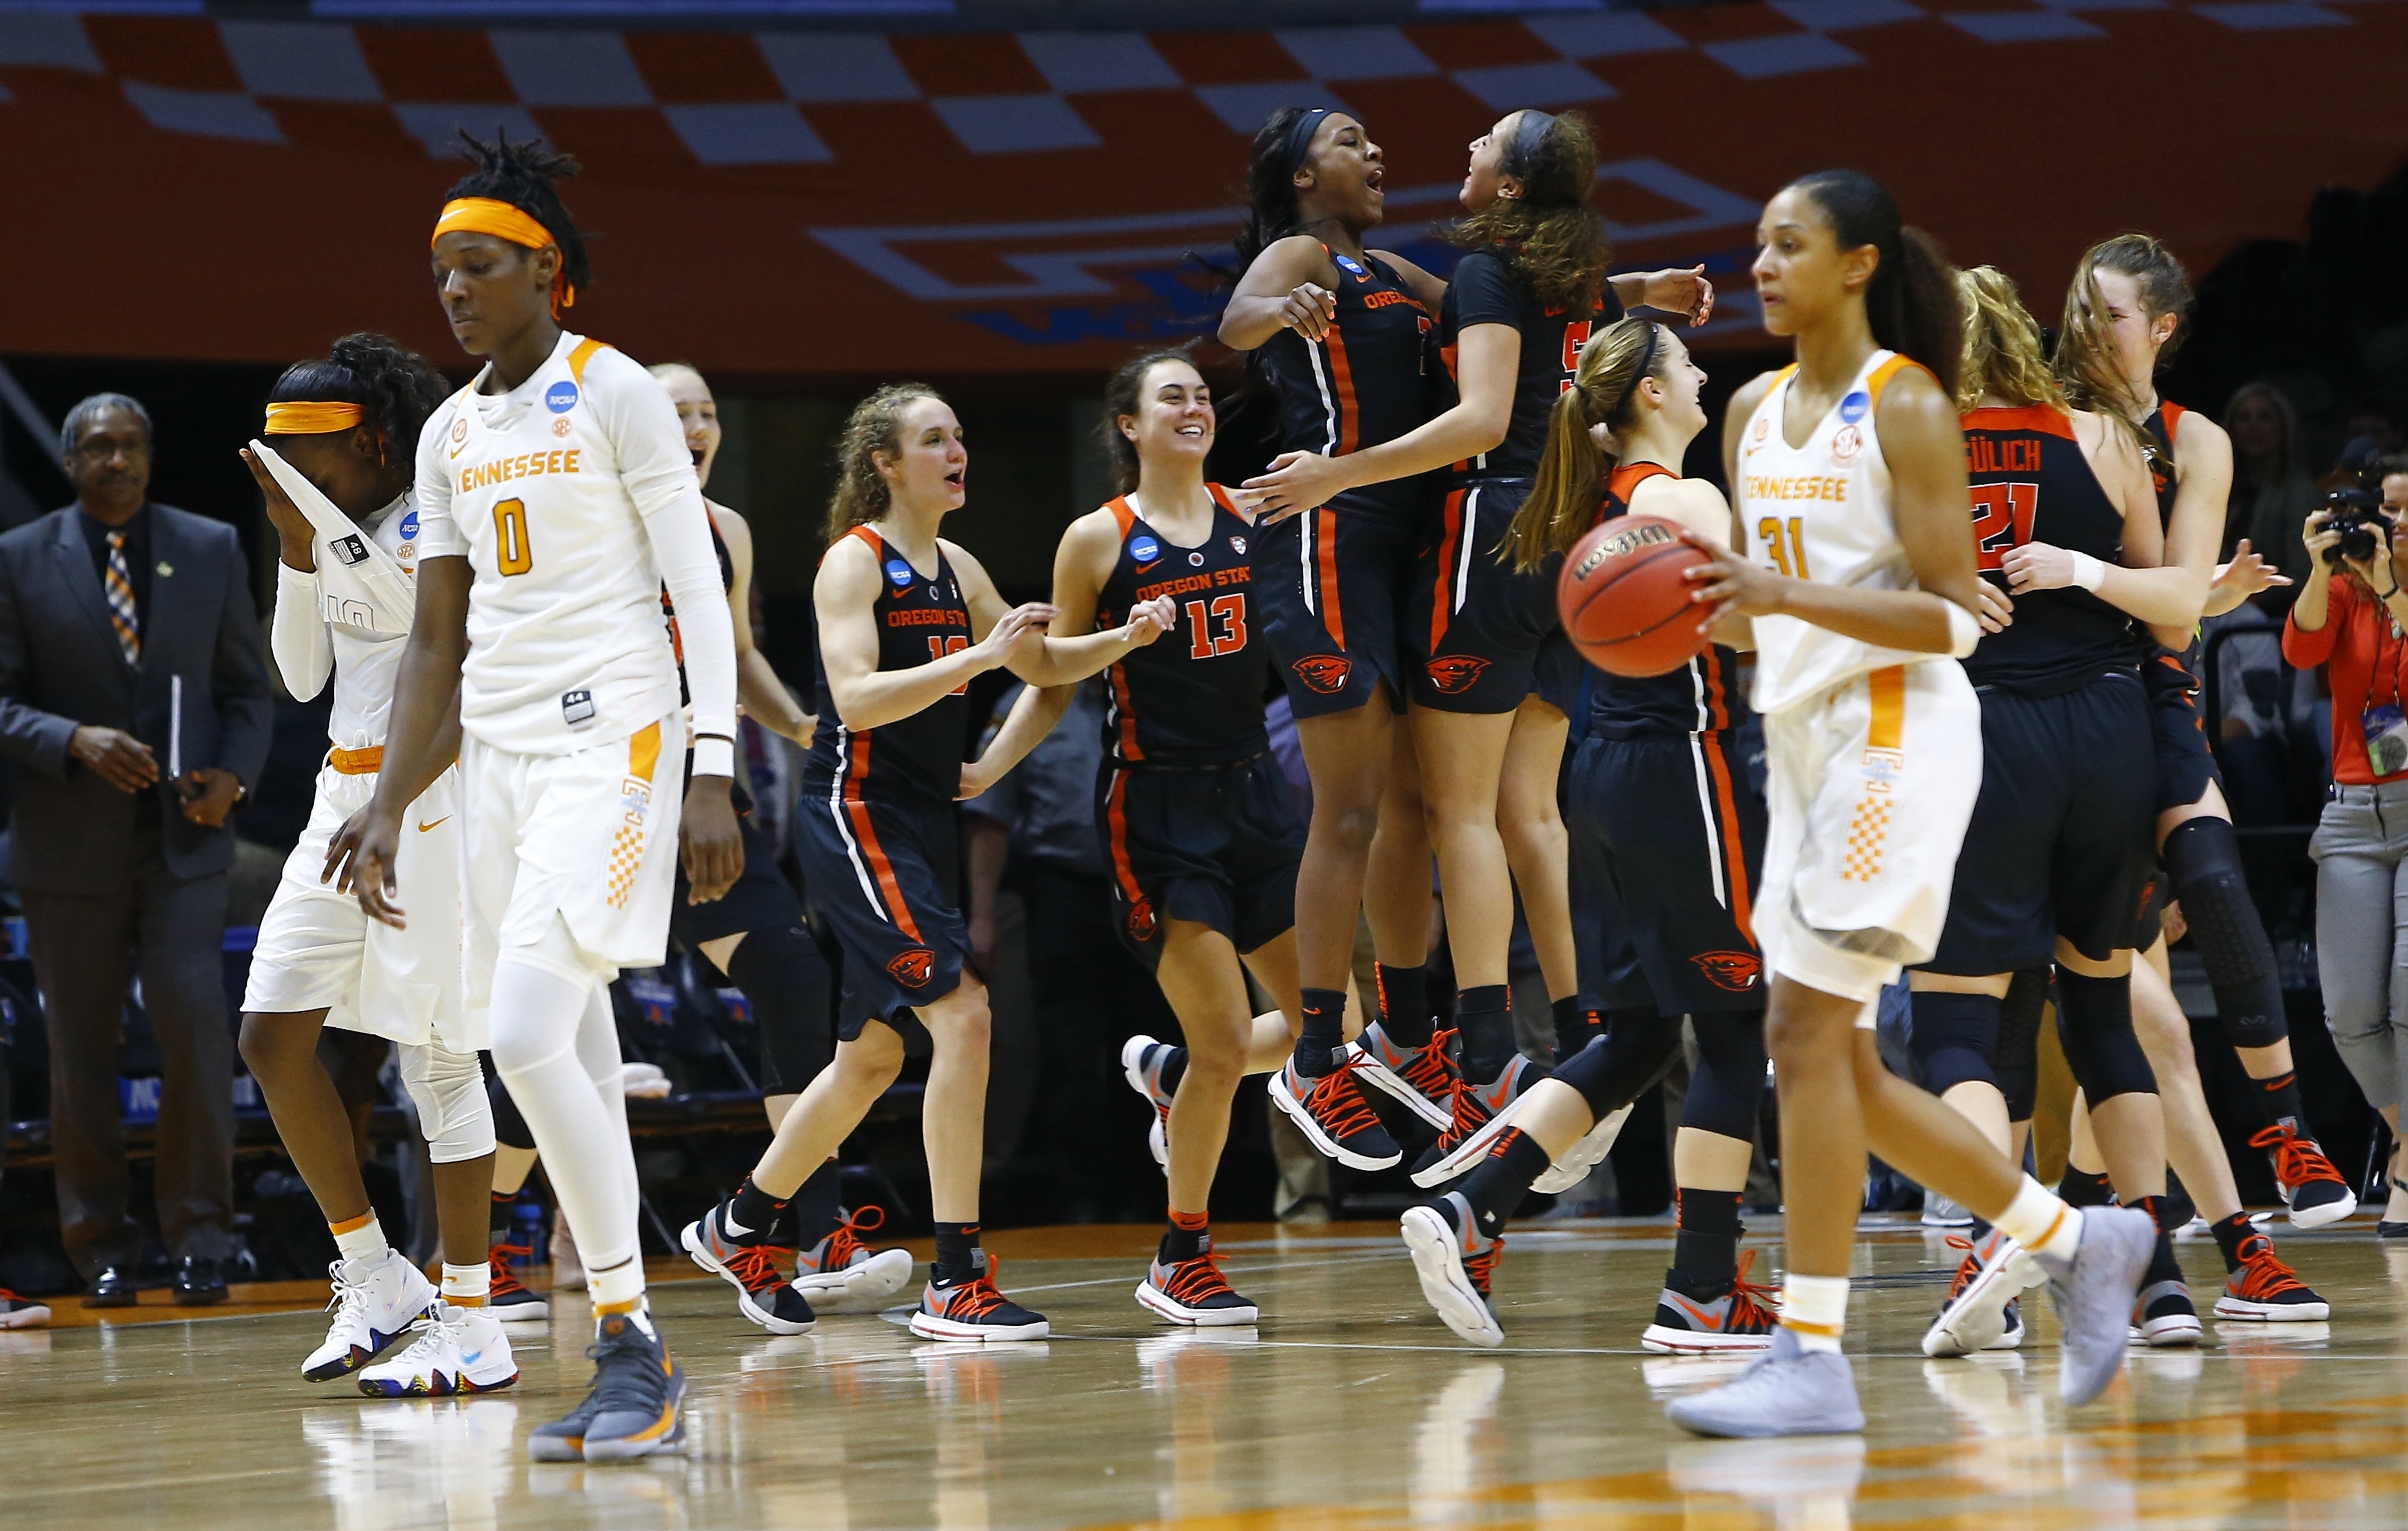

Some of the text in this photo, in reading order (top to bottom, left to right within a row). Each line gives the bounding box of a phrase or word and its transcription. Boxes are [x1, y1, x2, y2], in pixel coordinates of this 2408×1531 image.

[349, 542, 362, 555] 48
[492, 496, 533, 577] 0
[1758, 516, 1810, 580] 31
[1967, 481, 2039, 572] 21
[1135, 573, 1214, 602] OREGON
[887, 608, 946, 627] OREGON
[1185, 592, 1248, 660] 13
[566, 691, 585, 704] 44
